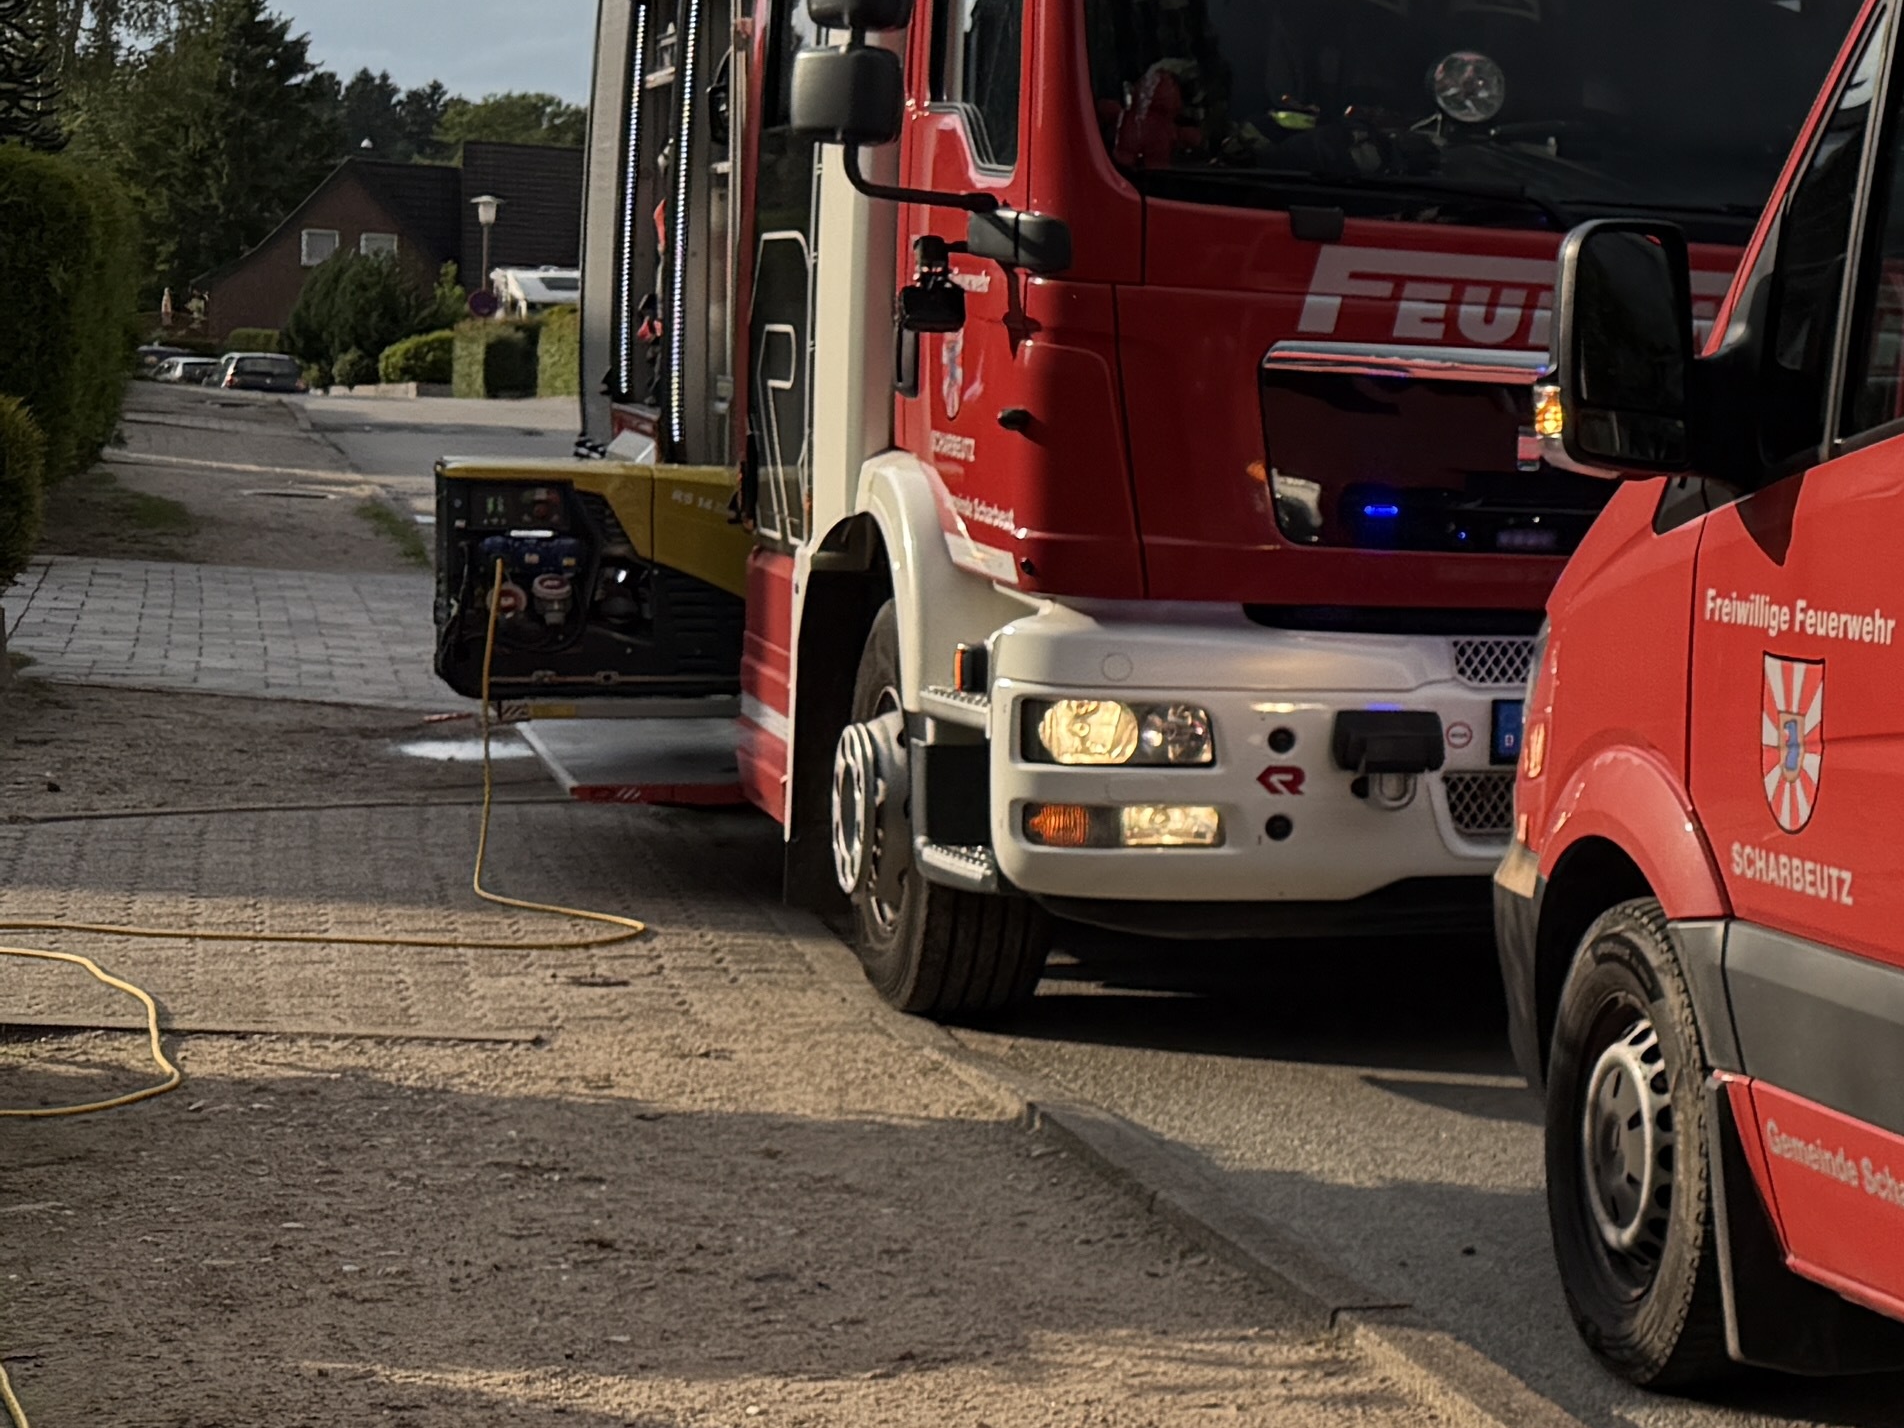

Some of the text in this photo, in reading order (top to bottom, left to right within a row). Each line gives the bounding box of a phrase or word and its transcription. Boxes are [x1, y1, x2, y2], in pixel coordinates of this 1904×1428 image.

[1705, 588, 1896, 645] Freiwillige Feuerwehr
[1731, 840, 1853, 906] SCHARBEUTZ
[1766, 1119, 1859, 1188] Gemeinde
